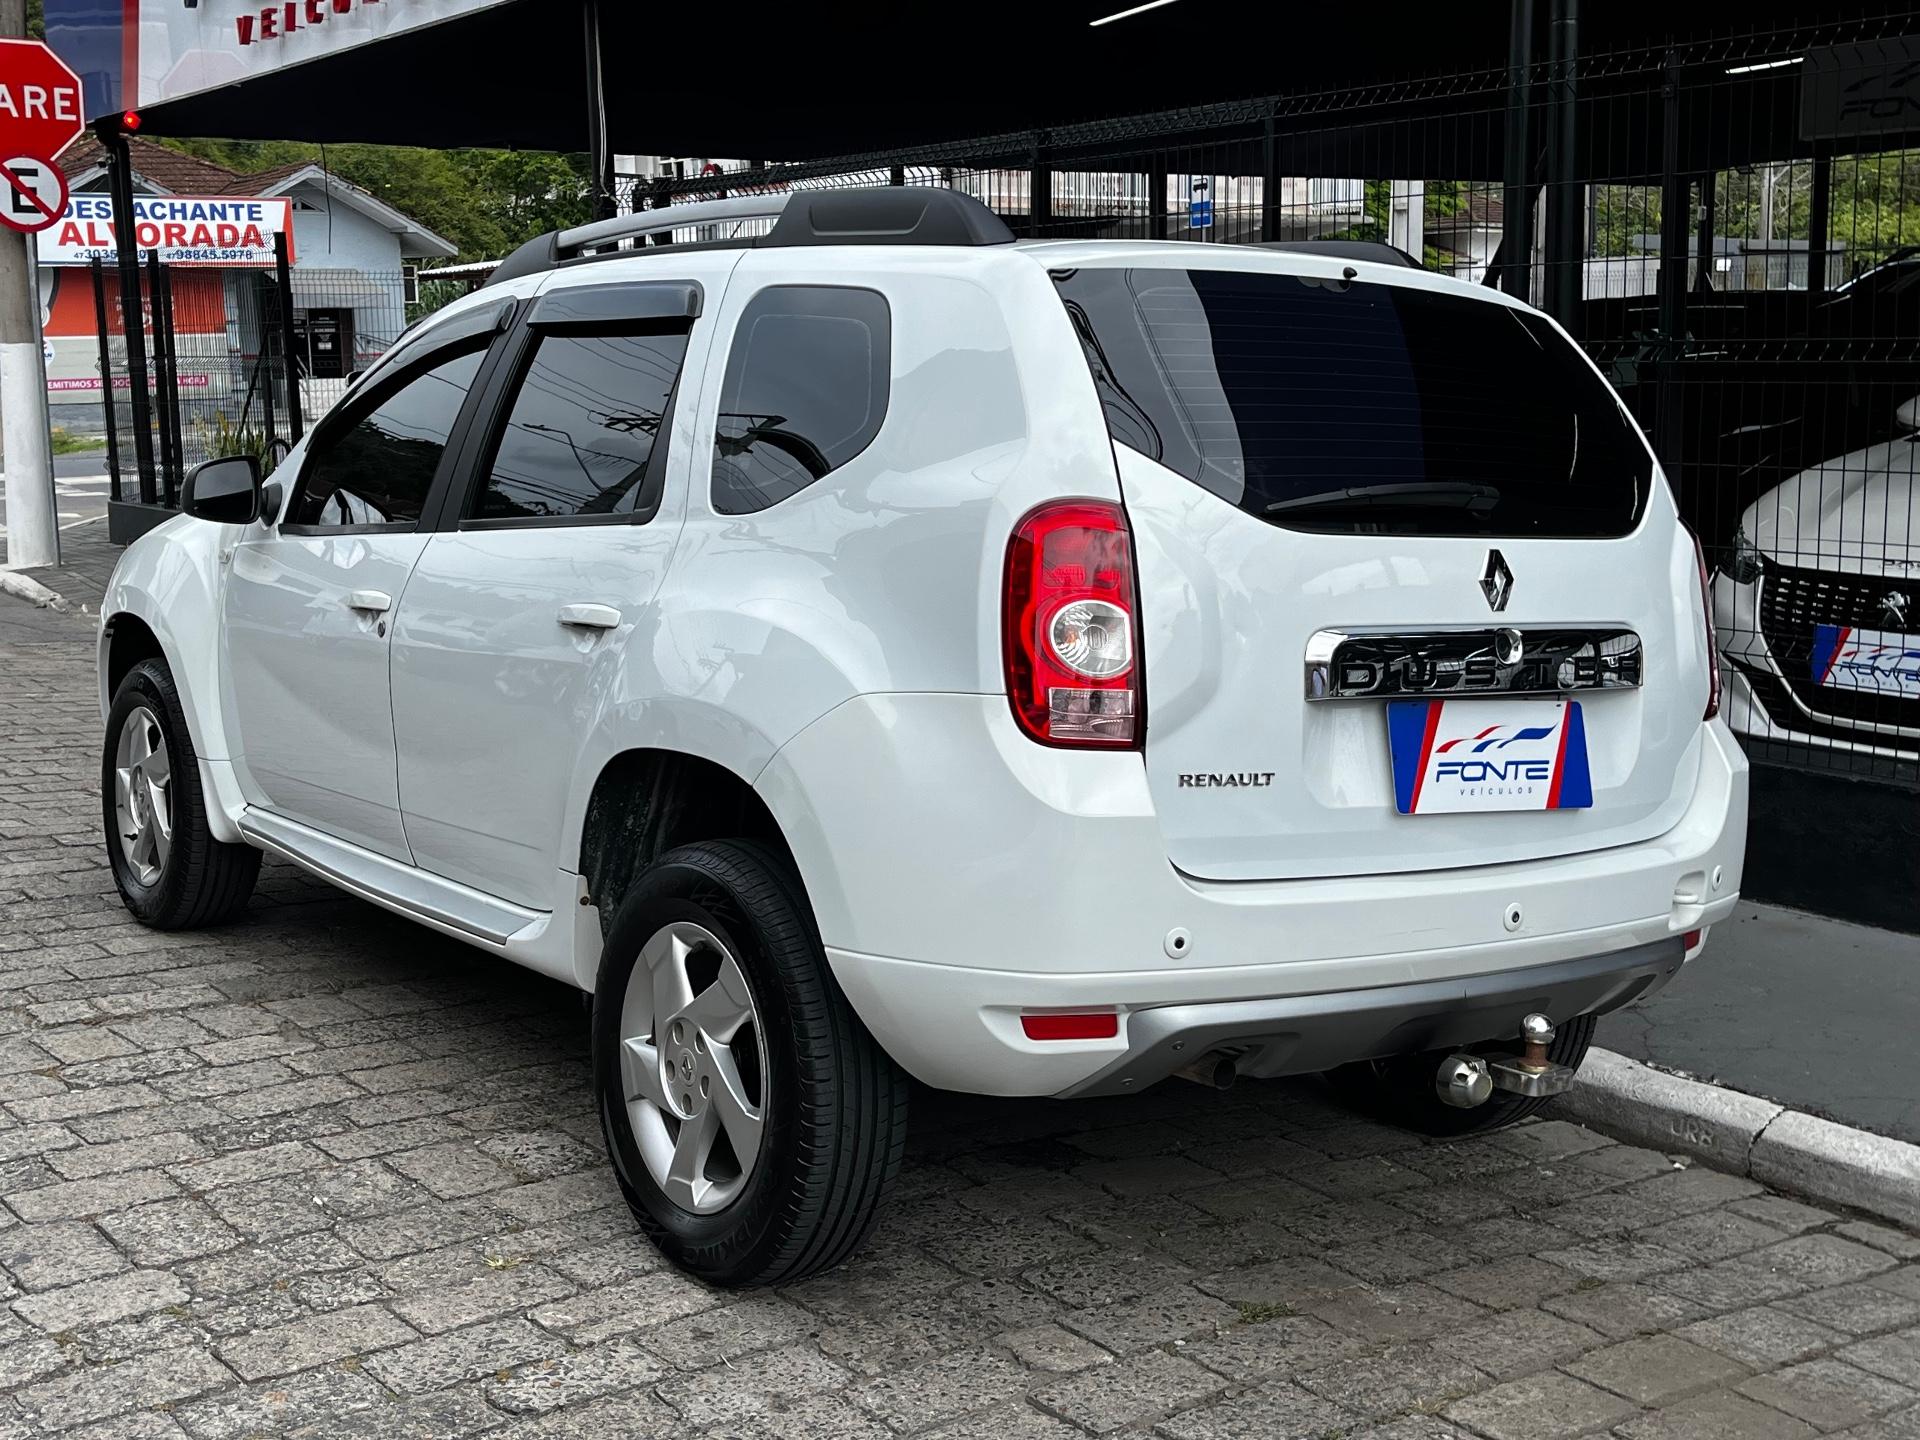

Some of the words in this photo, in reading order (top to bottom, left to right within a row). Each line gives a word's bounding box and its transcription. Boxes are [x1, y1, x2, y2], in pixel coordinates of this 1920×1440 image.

[62, 200, 263, 221] ESACHANTE
[48, 380, 91, 390] EMITIMOS
[1338, 656, 1638, 690] DUSTER
[1177, 772, 1276, 788] RENAULT
[1435, 760, 1550, 782] FONTE
